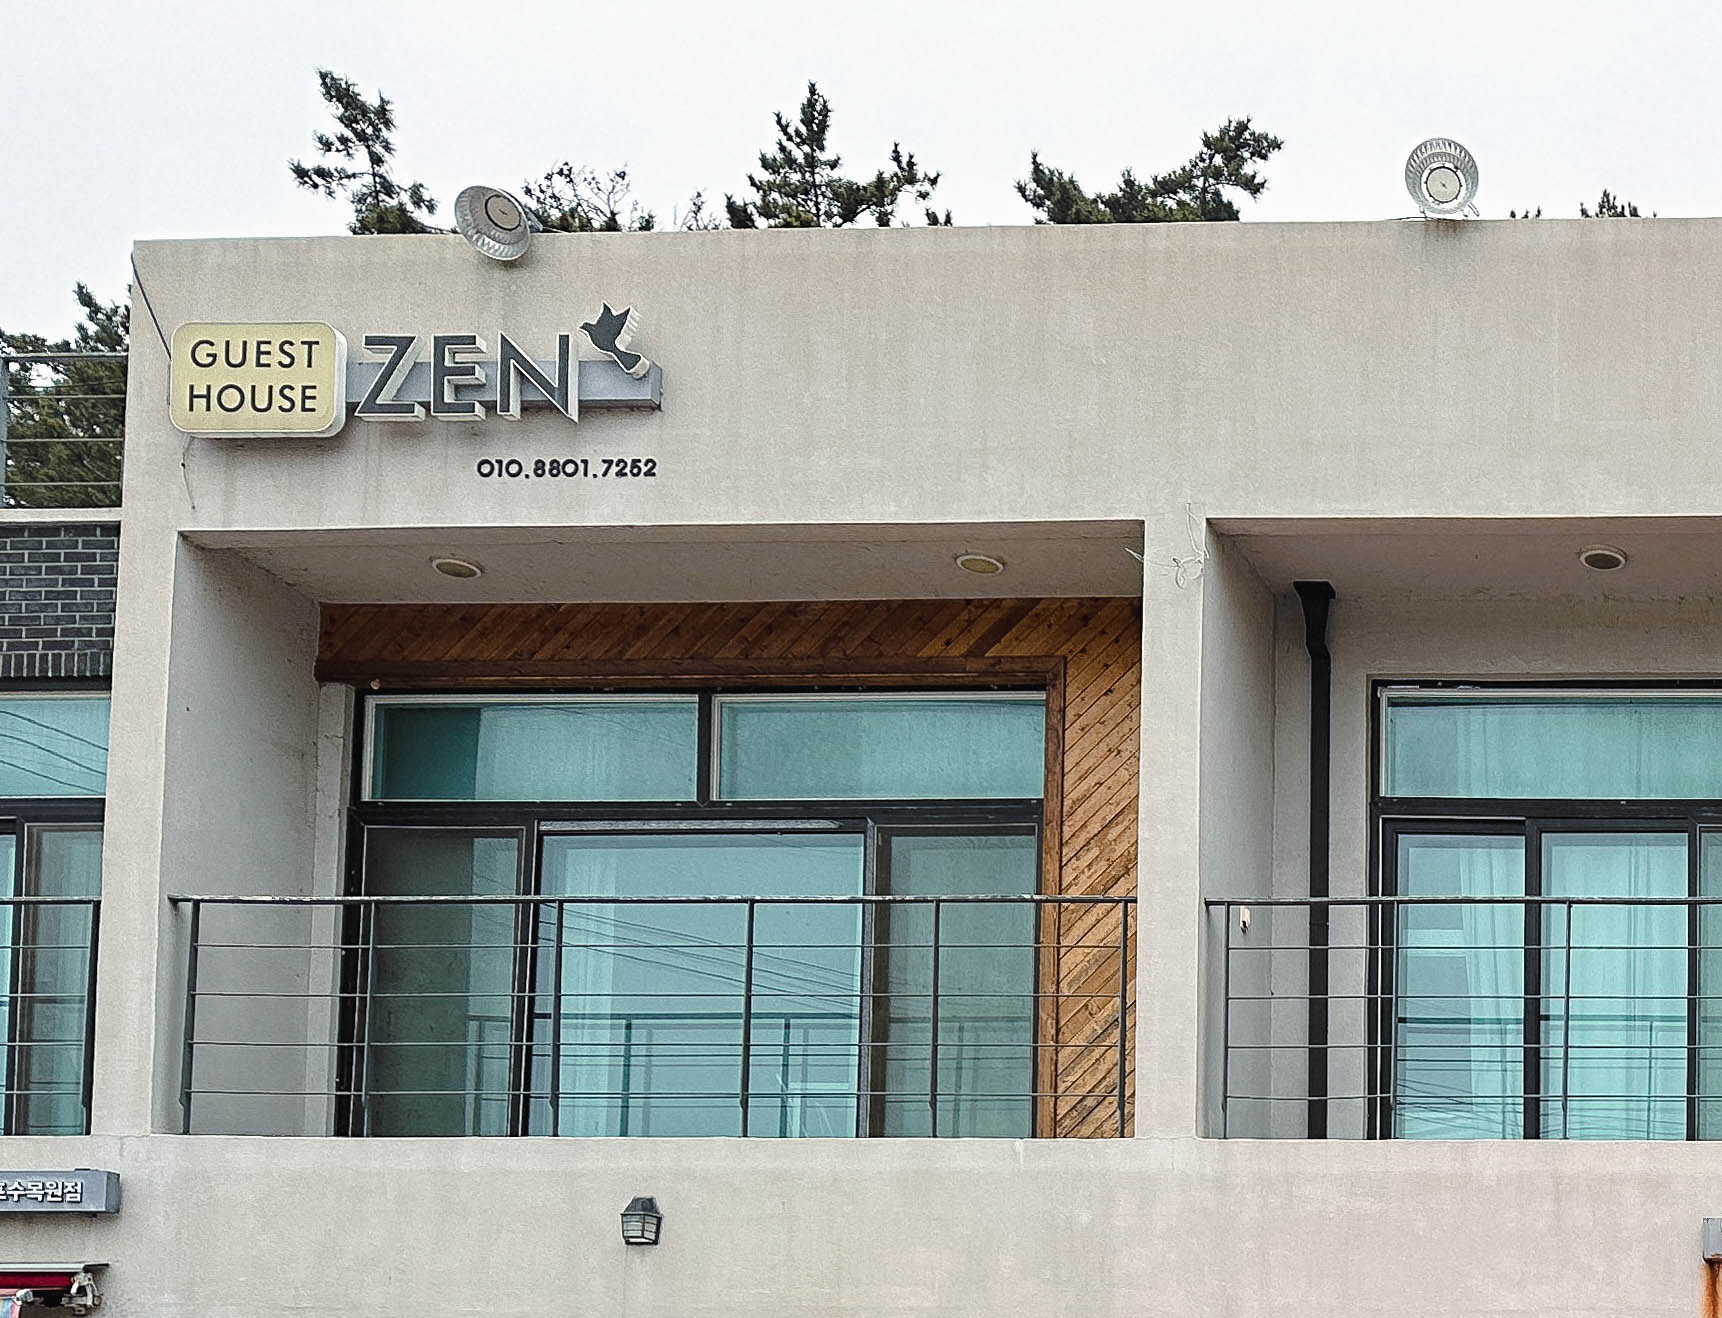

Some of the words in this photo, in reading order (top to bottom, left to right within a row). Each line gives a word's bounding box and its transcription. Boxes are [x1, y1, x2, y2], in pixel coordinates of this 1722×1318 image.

[190, 338, 321, 369] GUEST
[355, 331, 579, 423] ZEN
[188, 383, 318, 413] HOUSE
[476, 458, 657, 478] 010.8801.7252
